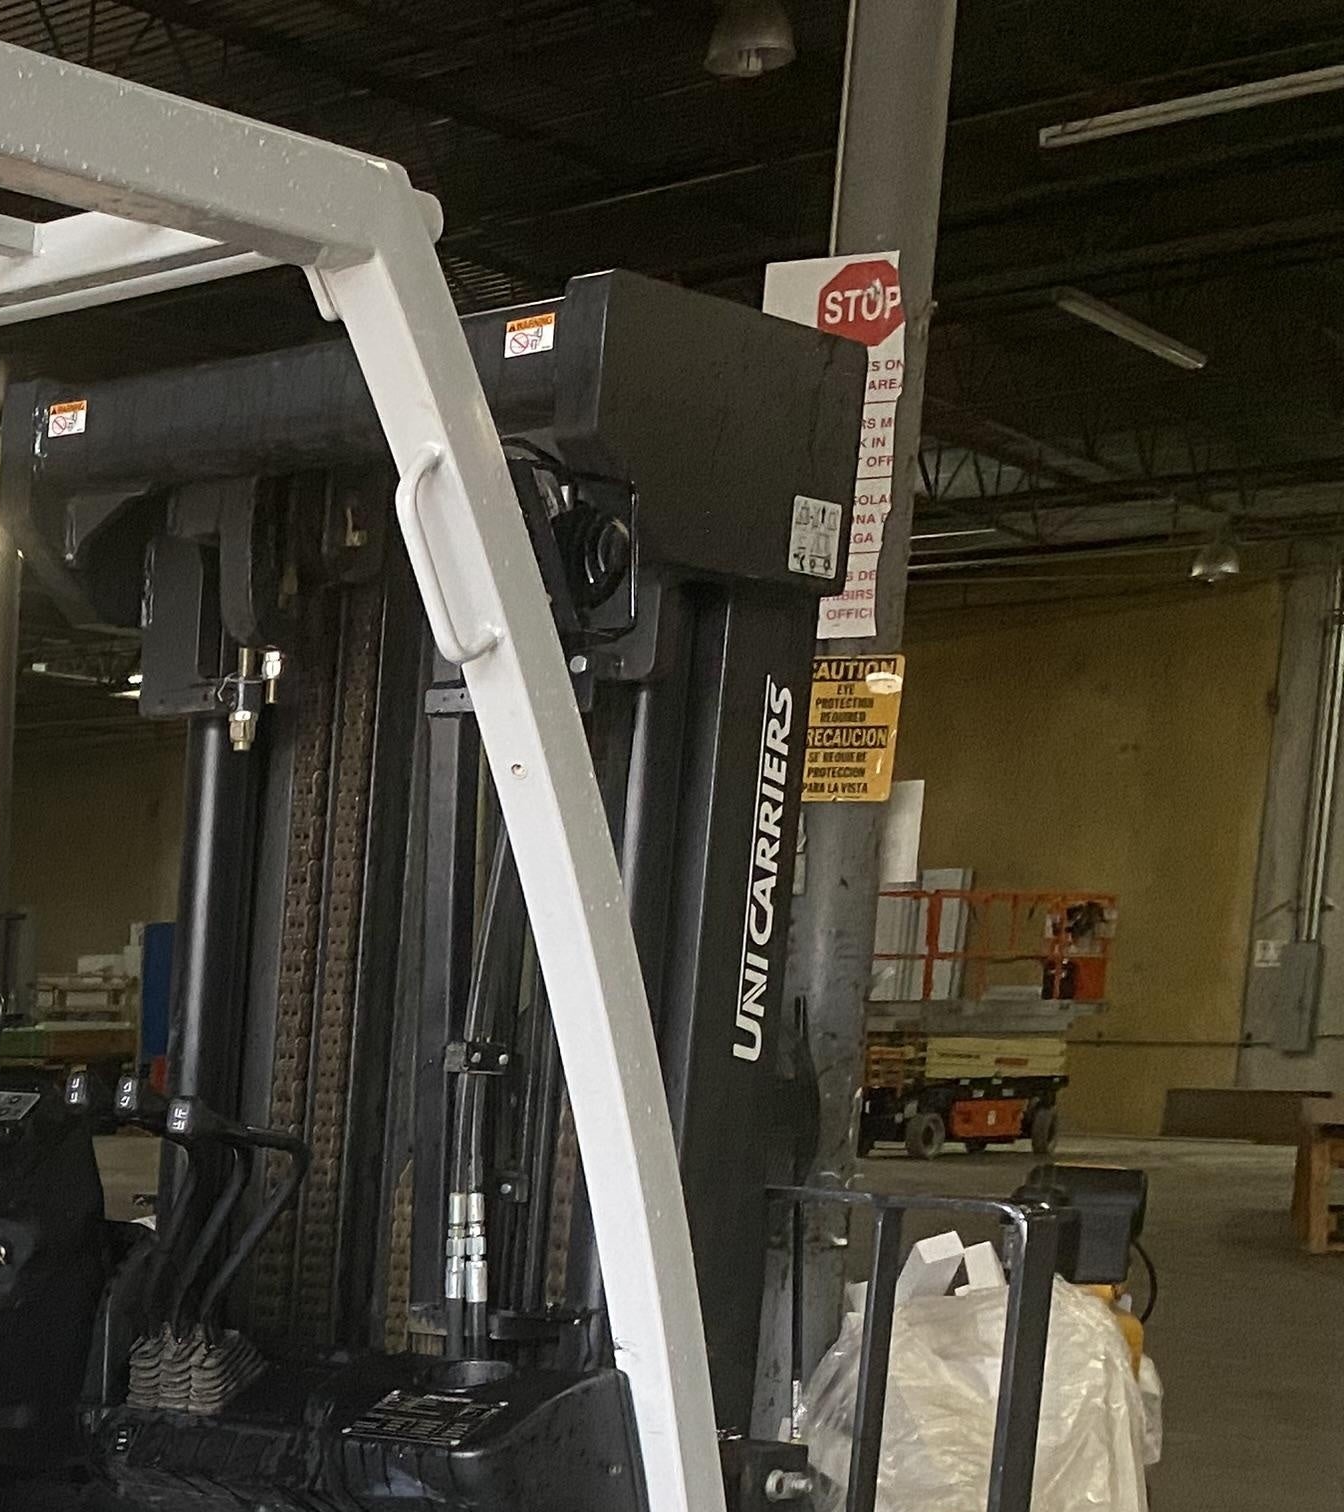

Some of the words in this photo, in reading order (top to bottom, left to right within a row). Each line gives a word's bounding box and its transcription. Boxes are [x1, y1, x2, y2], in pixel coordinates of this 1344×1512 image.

[824, 283, 901, 324] STOP
[868, 378, 902, 391] ARE
[871, 437, 886, 448] IN
[827, 782, 839, 794] LA
[841, 782, 868, 794] VISTA
